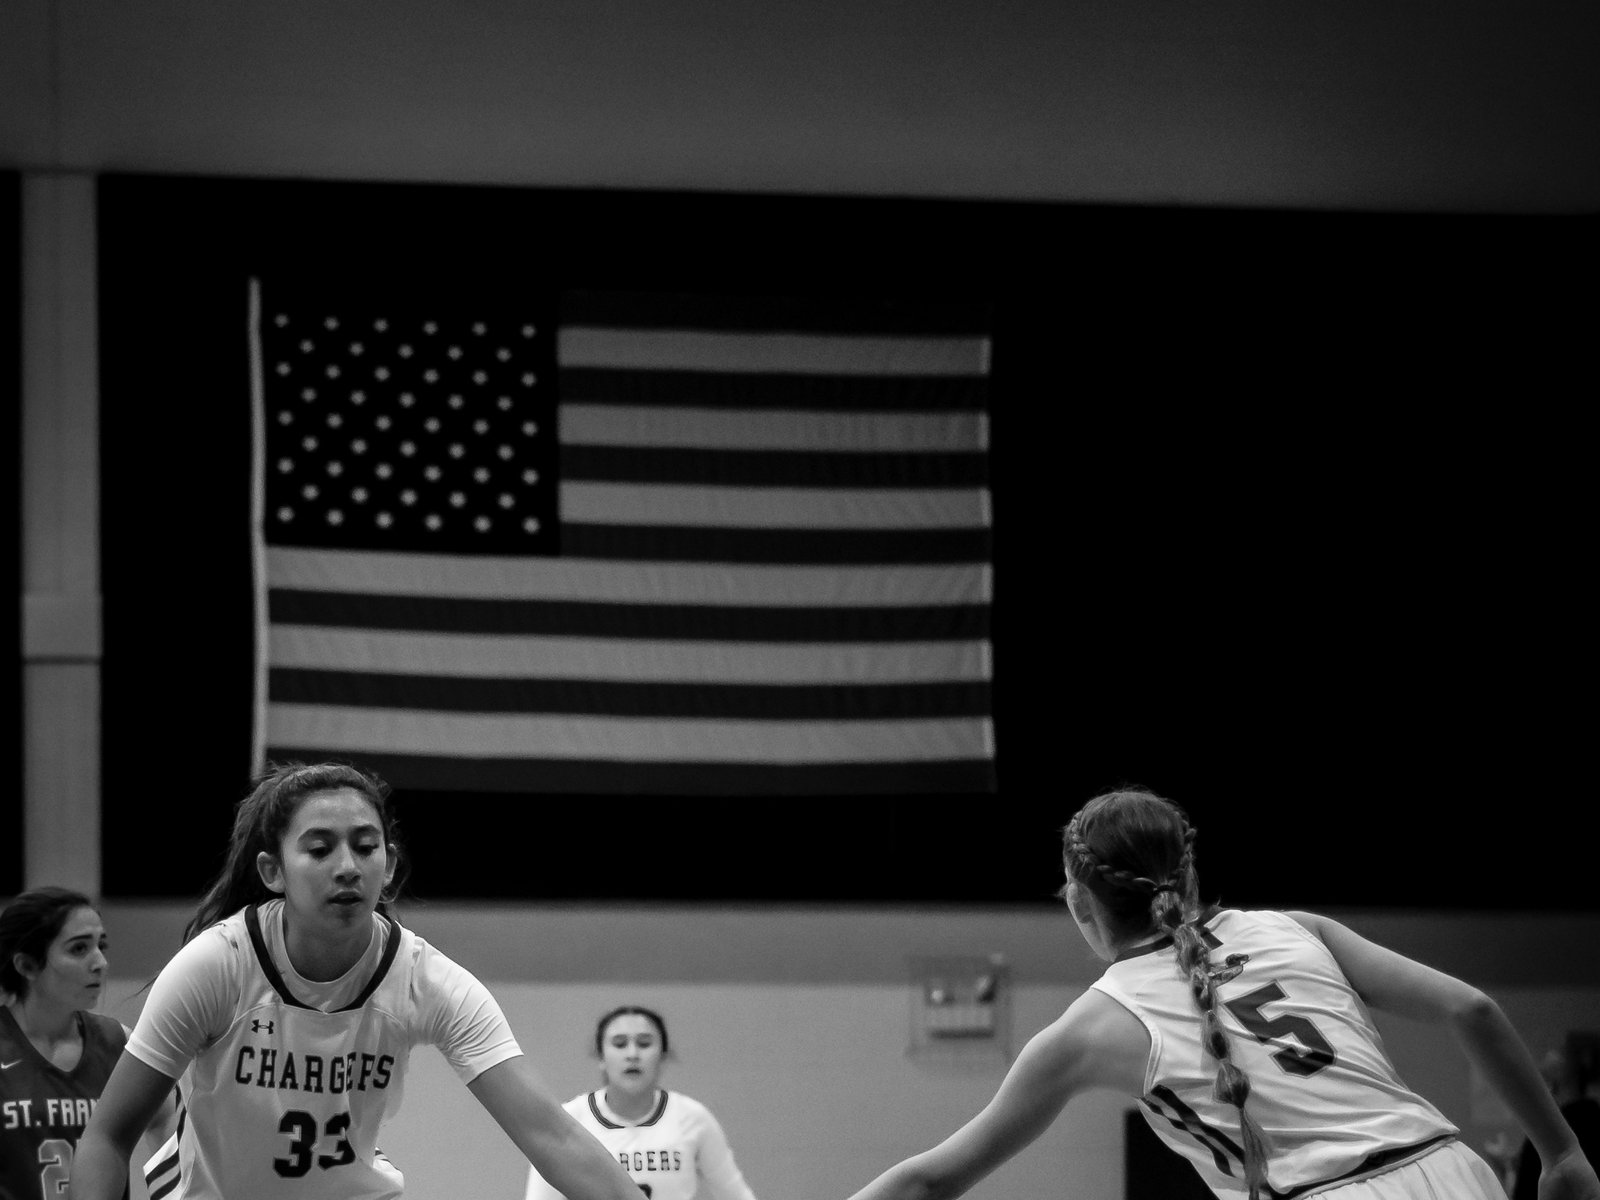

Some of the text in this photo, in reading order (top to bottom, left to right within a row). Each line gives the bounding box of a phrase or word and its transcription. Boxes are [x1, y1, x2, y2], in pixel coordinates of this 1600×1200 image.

[1219, 979, 1337, 1079] 5
[3, 1098, 99, 1129] ST. FRA
[273, 1110, 356, 1178] 33
